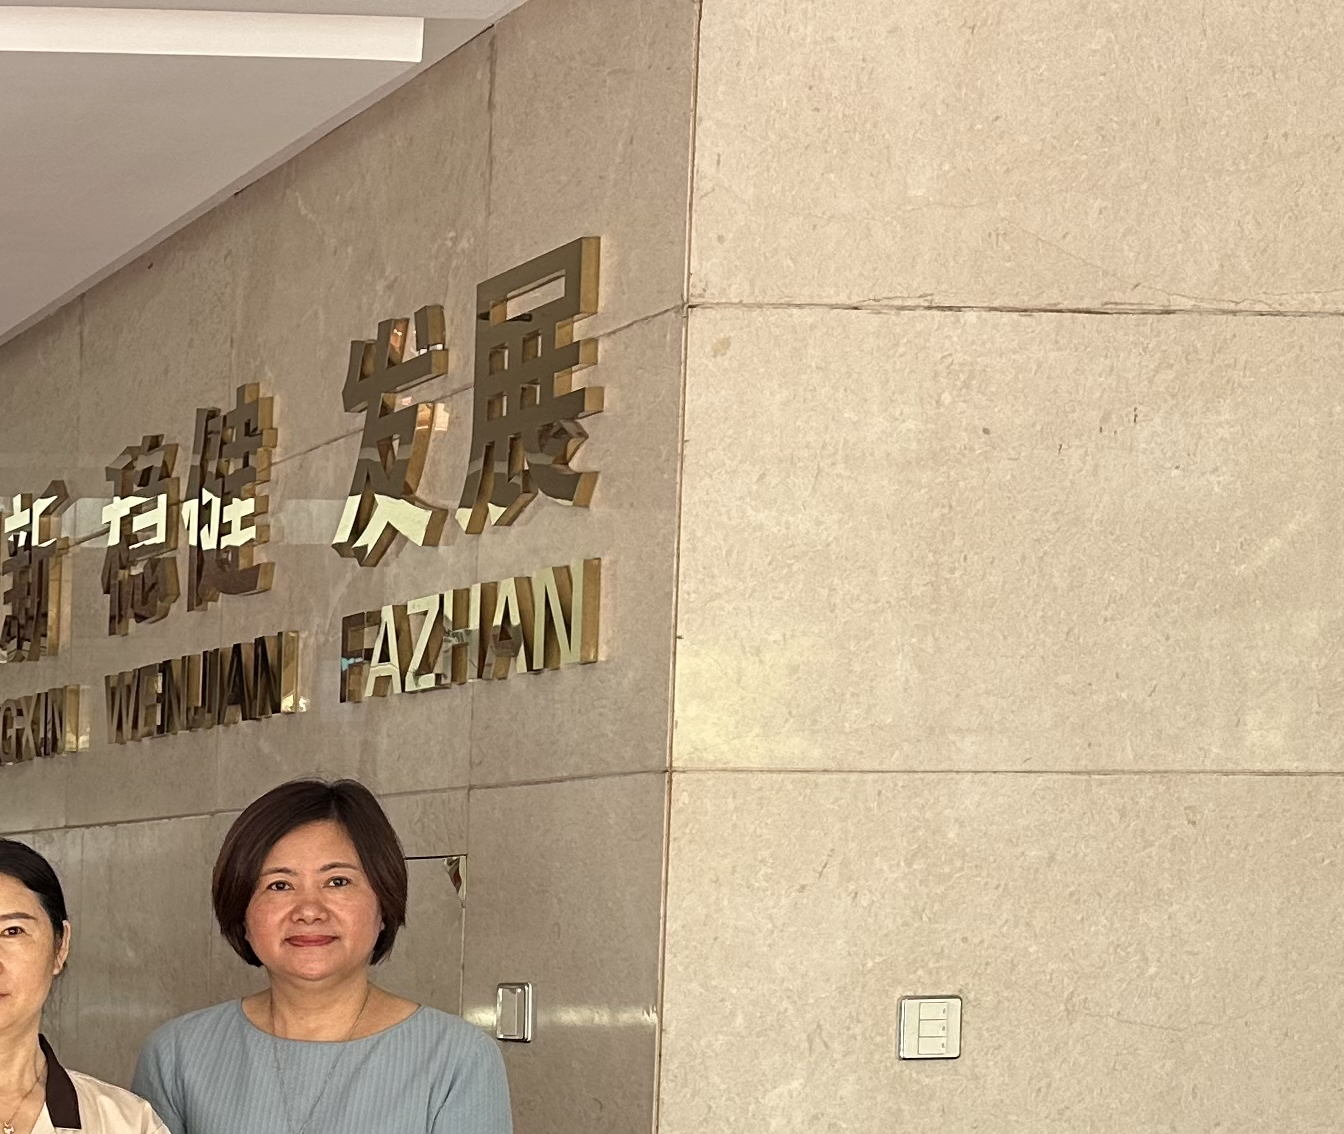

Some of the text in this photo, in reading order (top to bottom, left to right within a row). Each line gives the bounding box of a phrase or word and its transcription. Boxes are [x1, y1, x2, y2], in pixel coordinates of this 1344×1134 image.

[103, 384, 277, 637] 稳健
[332, 236, 605, 568] 发展
[104, 631, 301, 746] WENJIAN
[339, 557, 602, 704] FAZHAN
